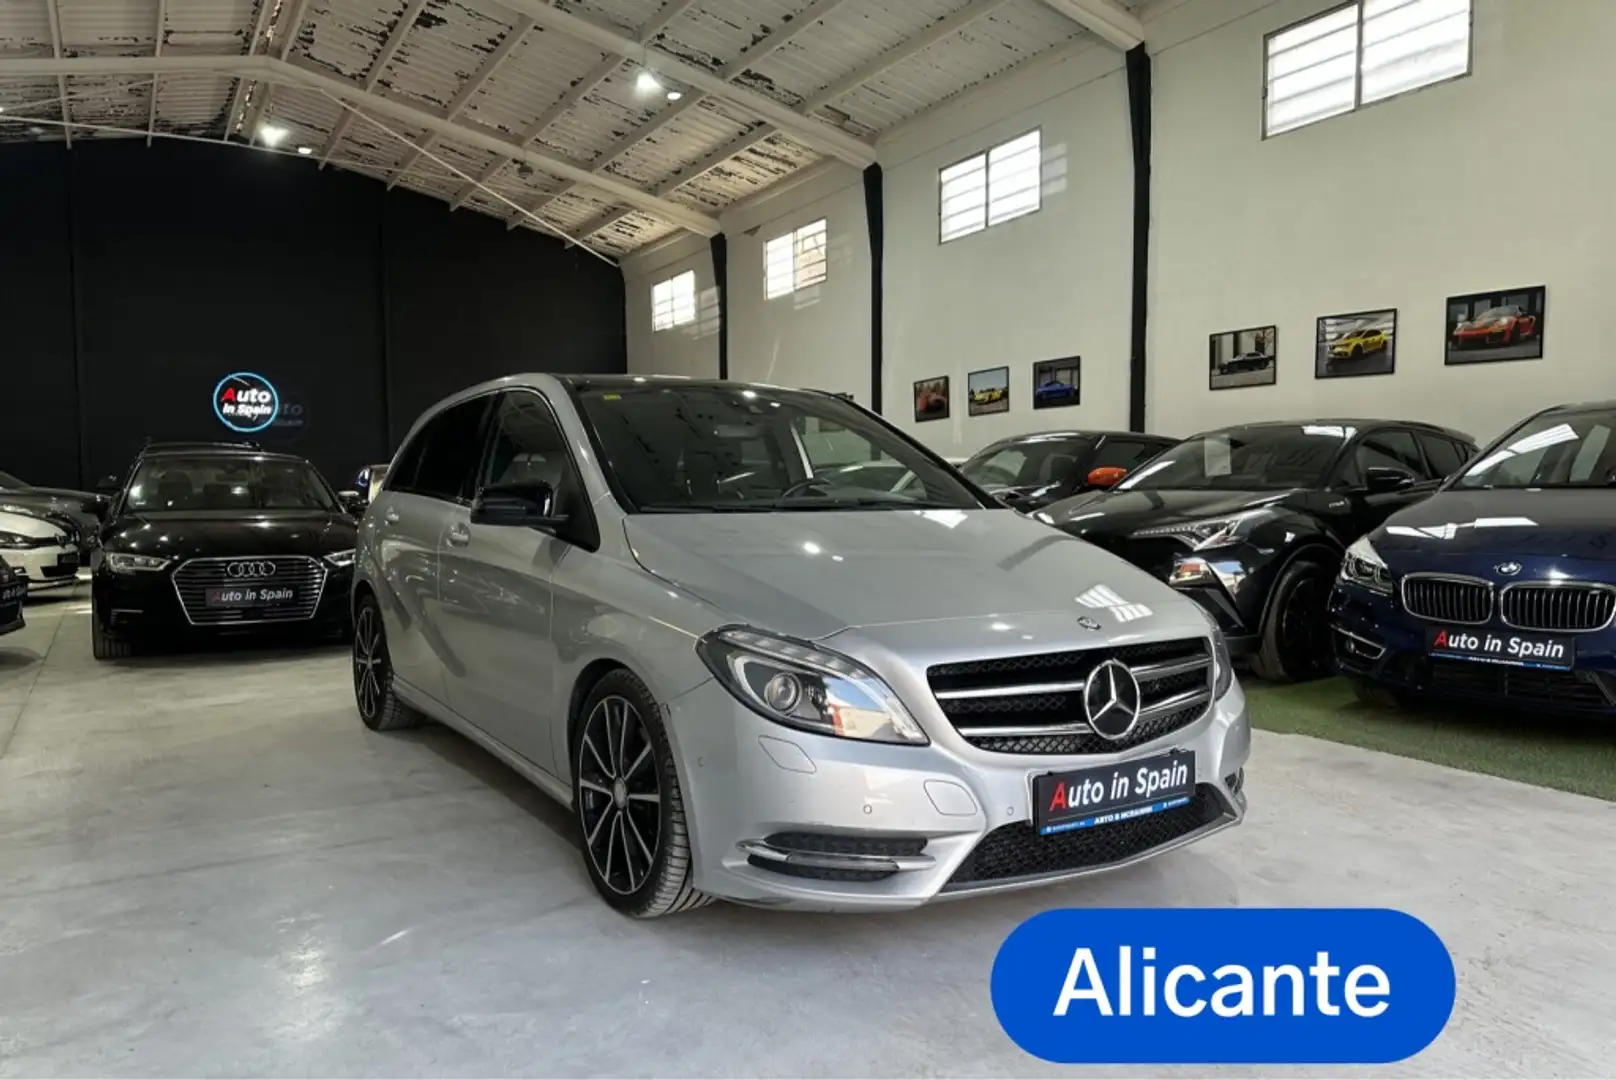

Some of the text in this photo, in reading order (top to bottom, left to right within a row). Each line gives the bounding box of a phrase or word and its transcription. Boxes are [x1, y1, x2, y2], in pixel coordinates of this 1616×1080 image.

[221, 387, 272, 403] Auto
[237, 403, 272, 418] Spain
[212, 591, 242, 602] Auto
[259, 587, 294, 601] Spain
[1433, 629, 1564, 658] Auto in Spain
[1048, 760, 1188, 812] Auto in Spain
